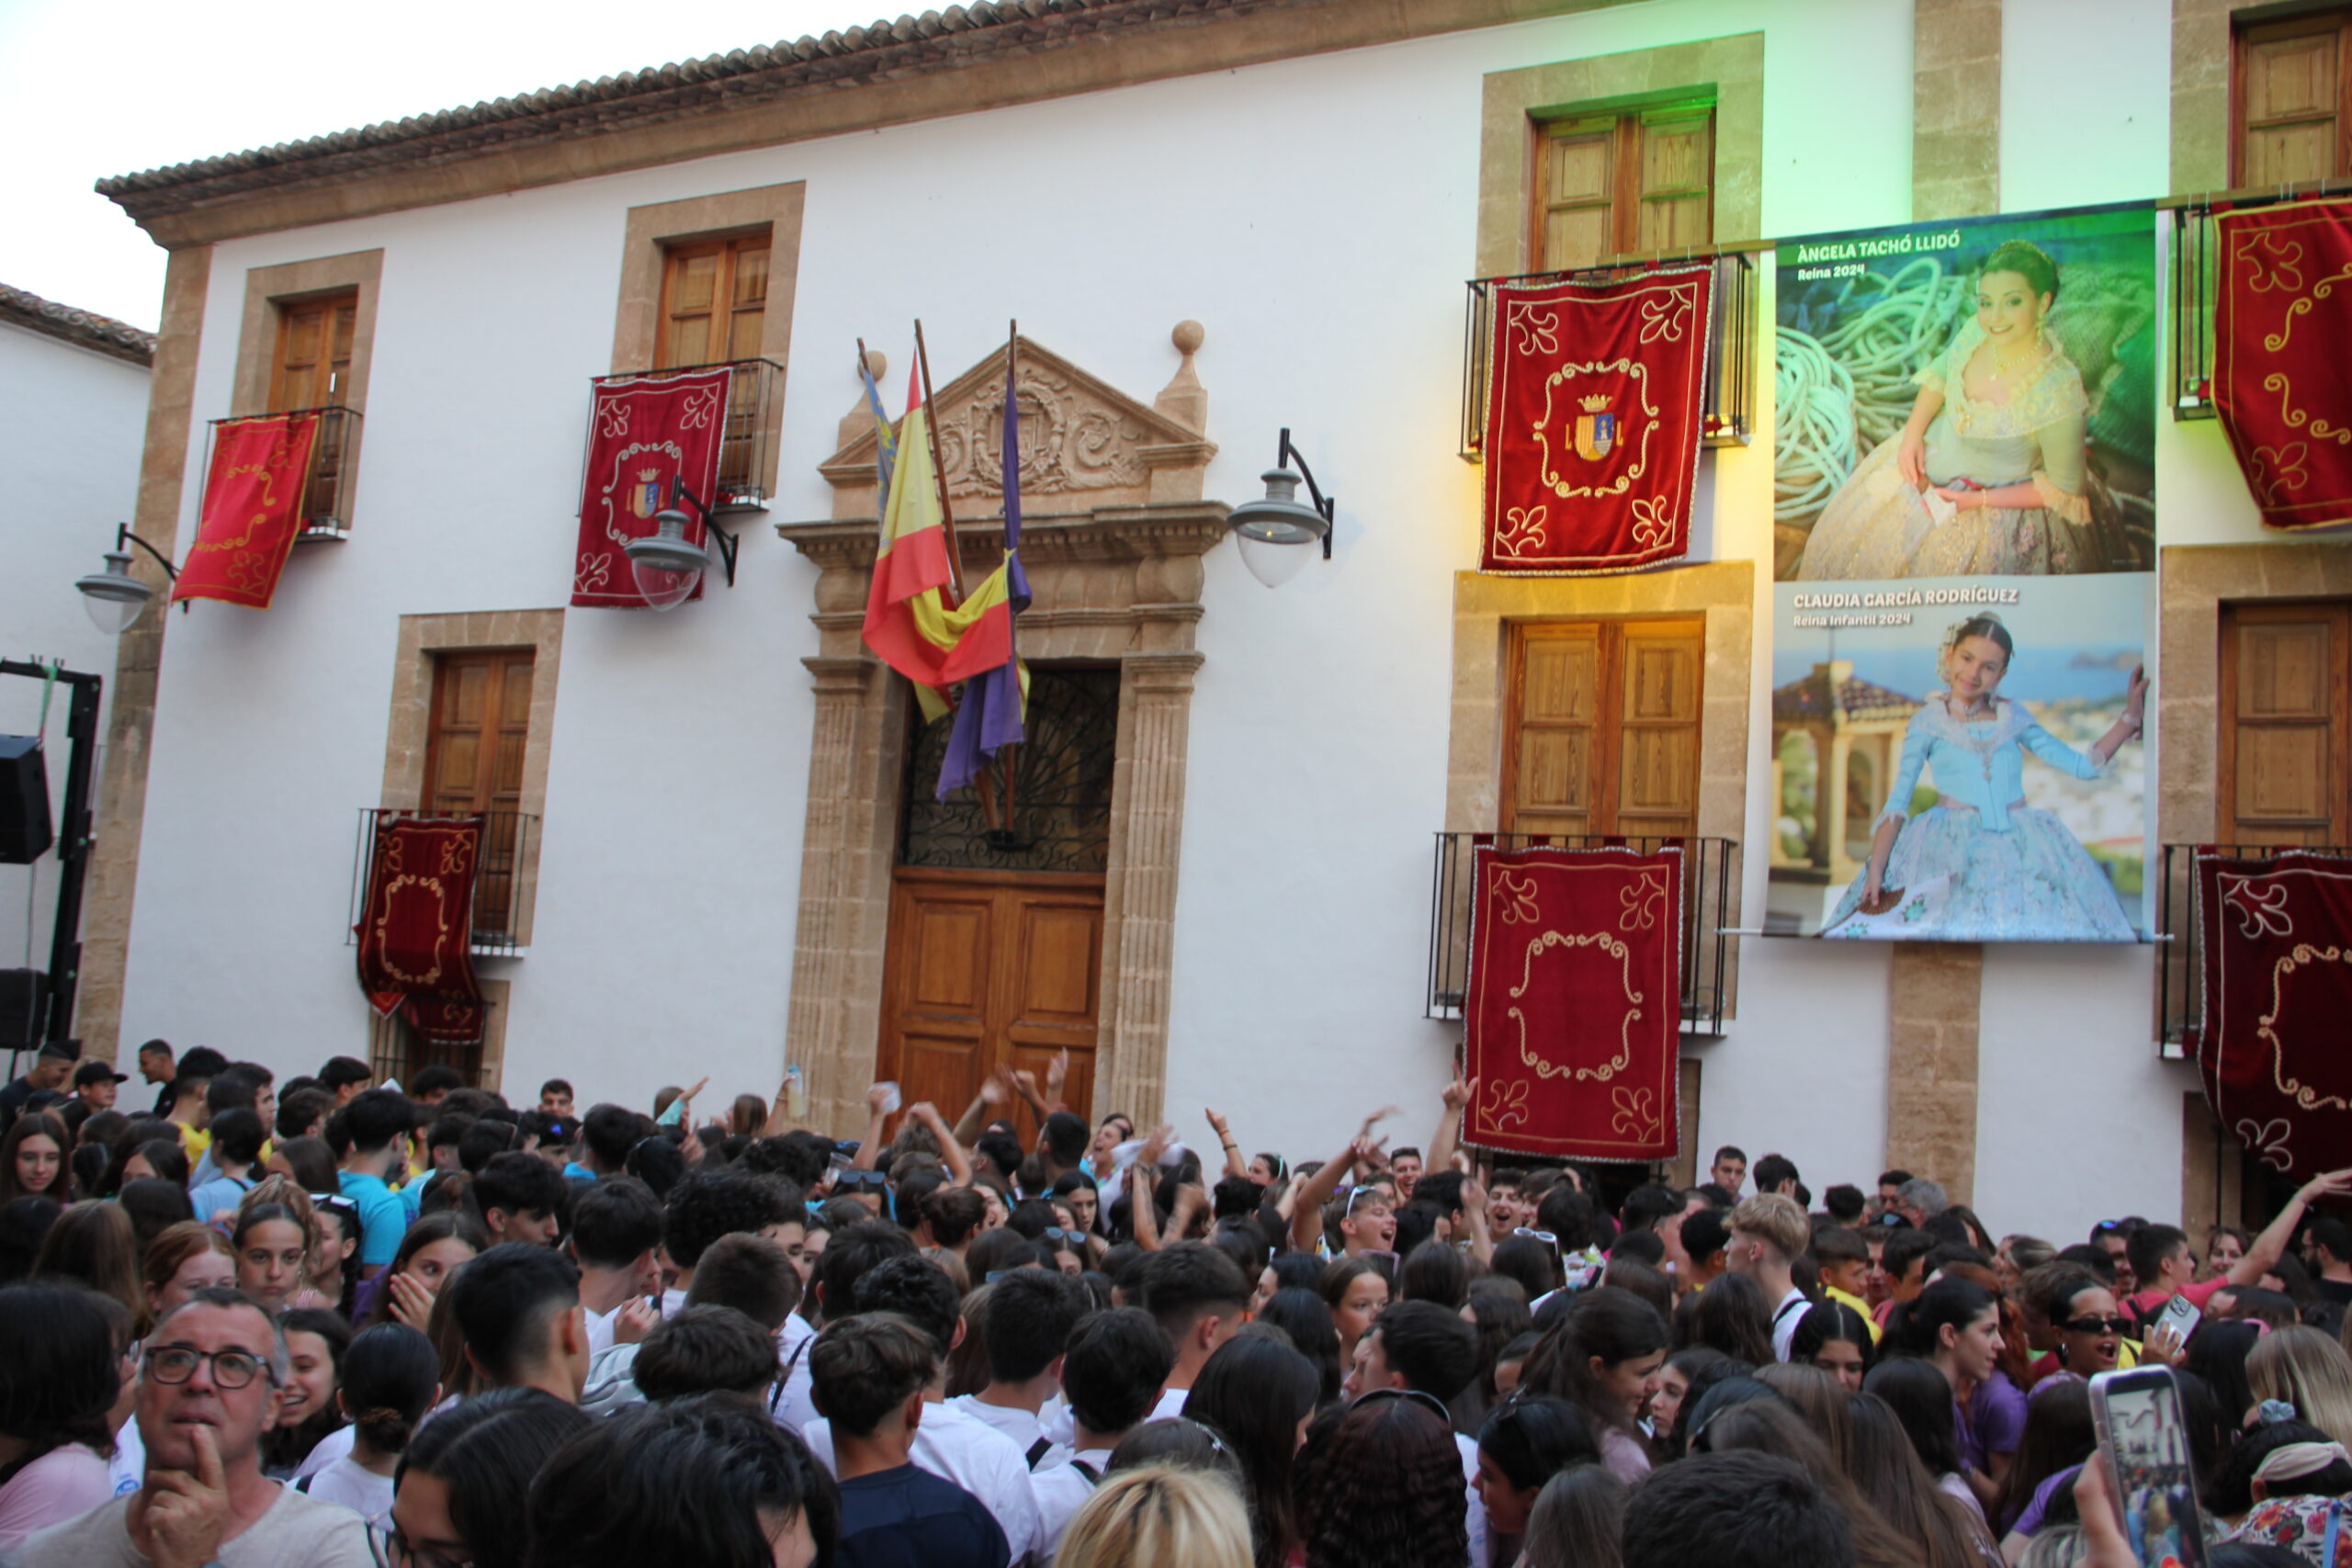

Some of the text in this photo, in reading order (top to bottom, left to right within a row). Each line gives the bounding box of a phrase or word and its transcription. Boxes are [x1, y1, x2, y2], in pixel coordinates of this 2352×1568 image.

[1797, 229, 1961, 264] ÀNGELA TACHÓ LLIDÓ
[1797, 264, 1865, 281] Reina 2024
[1793, 584, 2018, 608] CLAUDIA GARCÍA RODRÍGUEZ
[1793, 613, 1911, 626] Reina Infantil 2024
